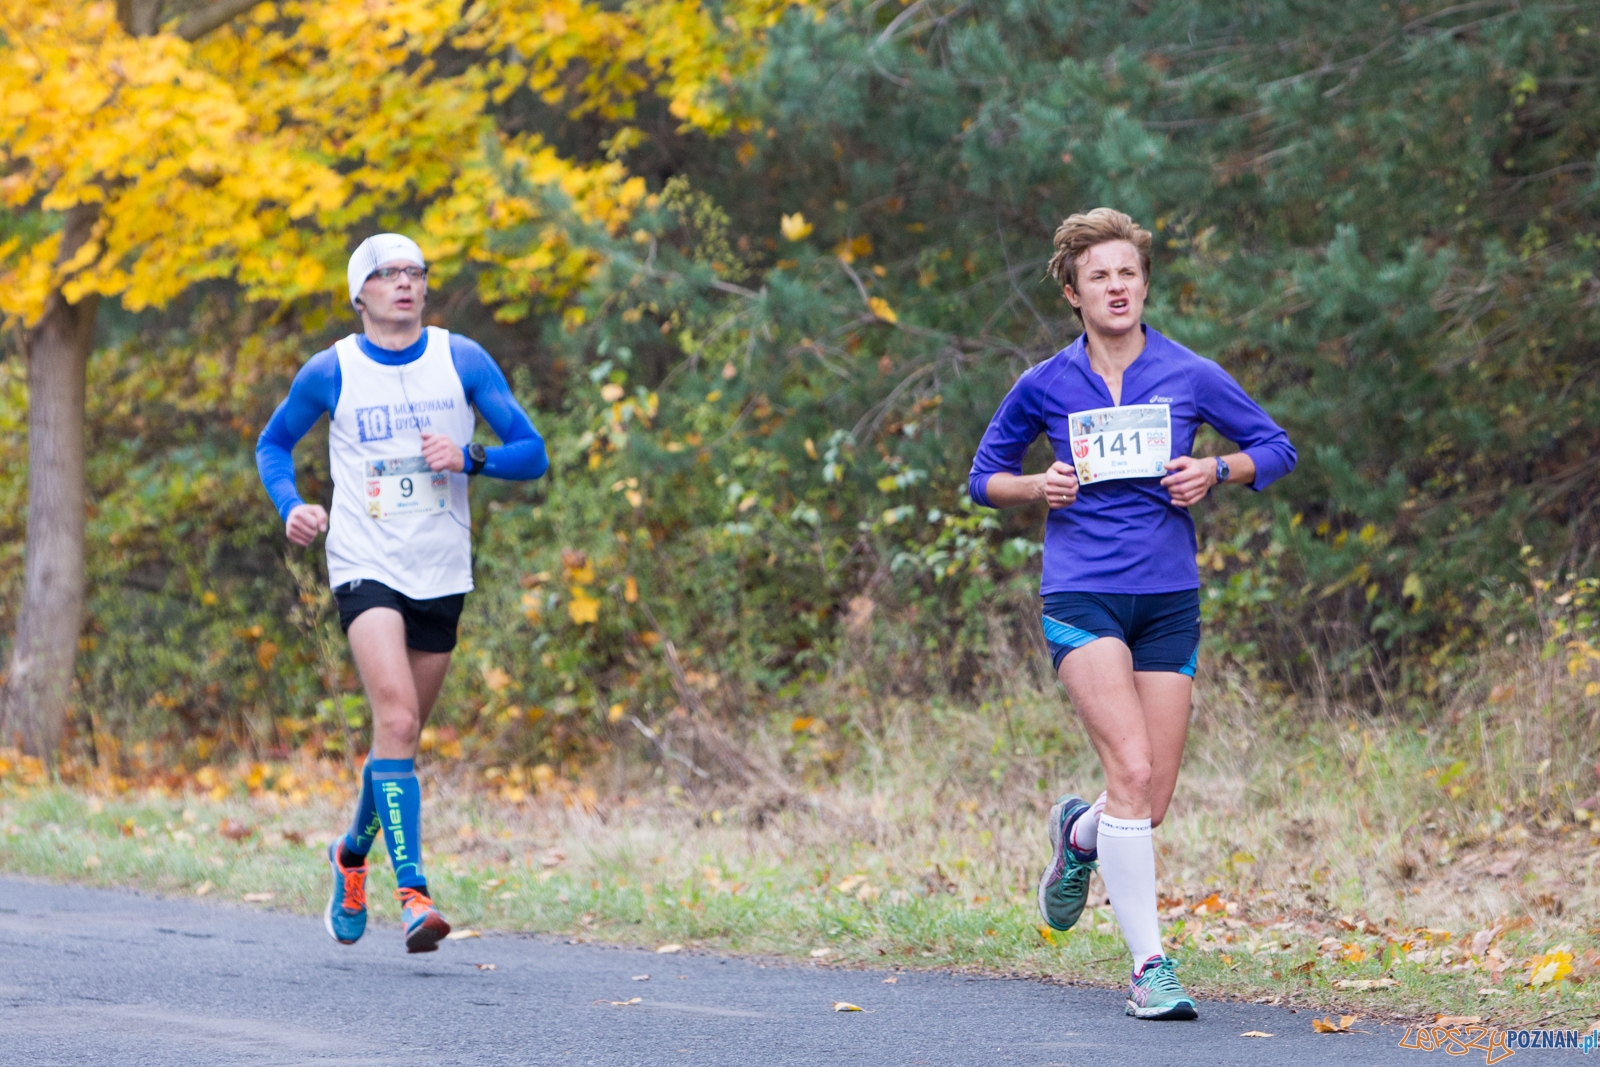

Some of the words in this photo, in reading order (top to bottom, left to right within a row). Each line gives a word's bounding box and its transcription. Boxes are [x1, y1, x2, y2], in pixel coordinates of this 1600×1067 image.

[394, 399, 455, 415] MUROWANA
[358, 408, 389, 439] 10
[395, 416, 431, 430] DYCHA
[1093, 431, 1142, 458] 141
[400, 477, 414, 498] 9
